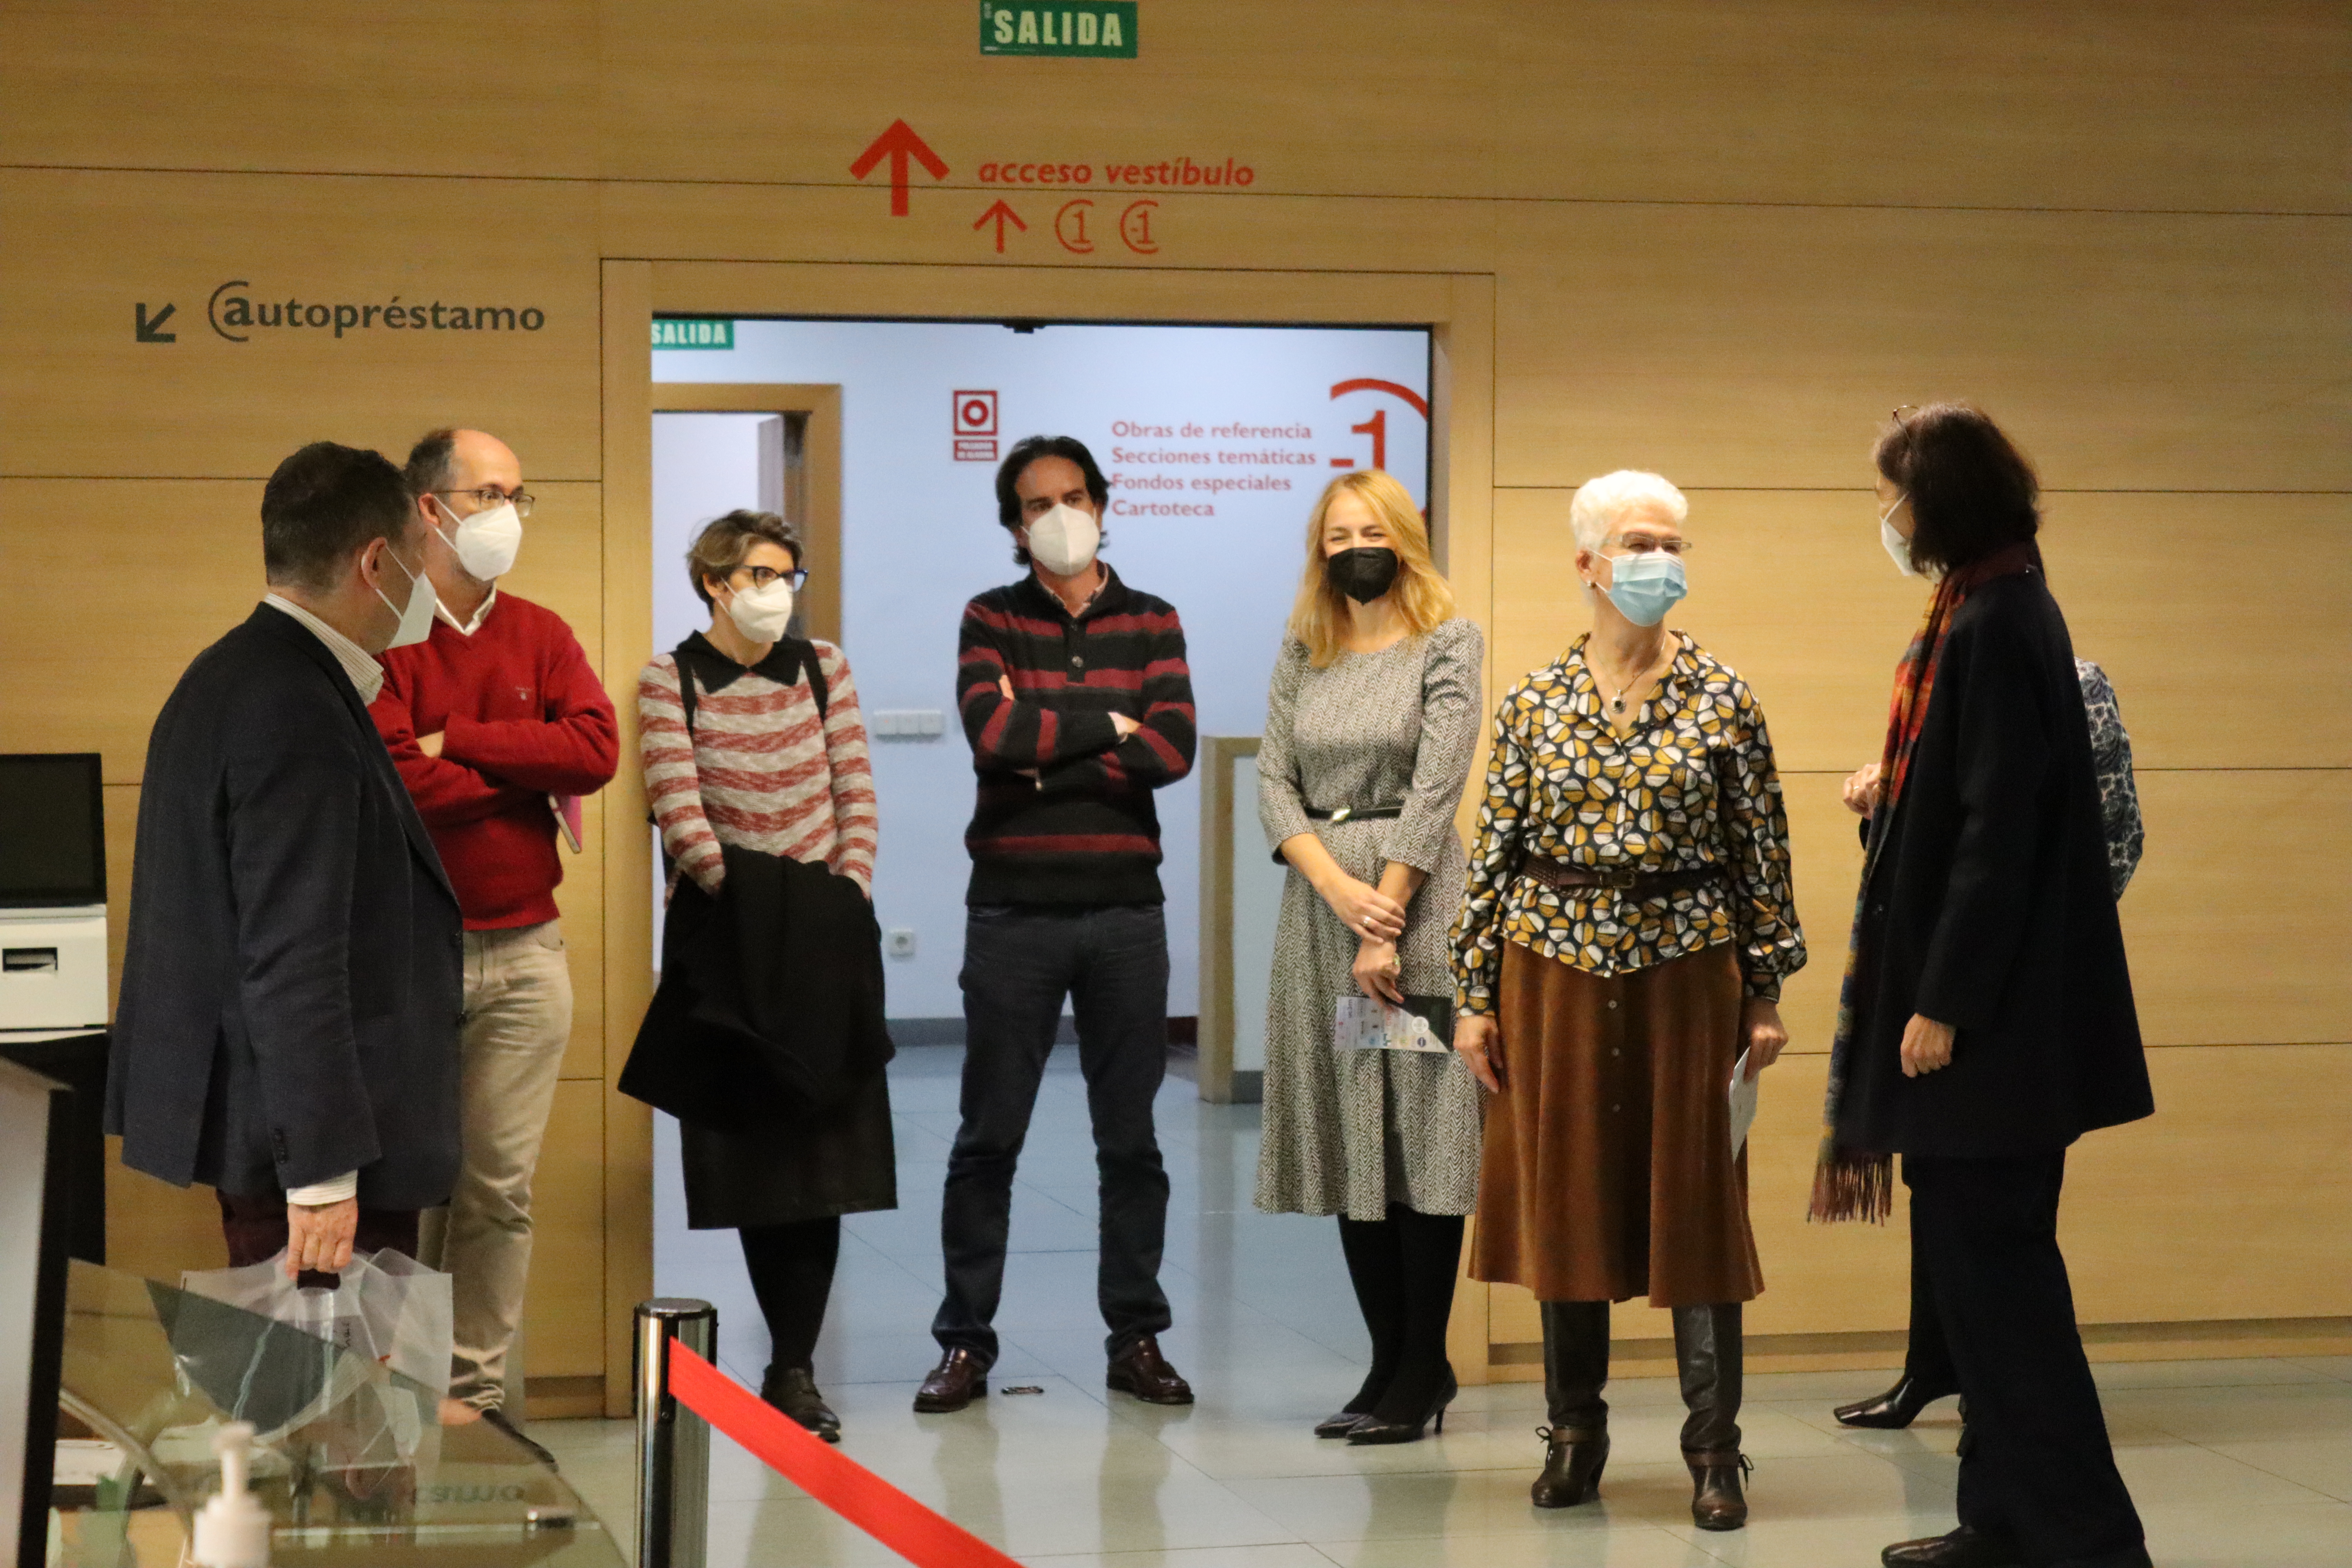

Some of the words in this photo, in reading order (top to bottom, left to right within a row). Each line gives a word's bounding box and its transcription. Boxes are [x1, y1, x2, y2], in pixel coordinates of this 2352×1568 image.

[994, 10, 1122, 46] SALIDA
[980, 163, 1091, 183] acceso
[1106, 157, 1253, 185] vestíbulo
[651, 323, 726, 344] SALIDA
[1112, 421, 1173, 437] Obras
[1180, 422, 1204, 437] de
[1211, 422, 1312, 438] referencia
[1112, 447, 1210, 464] Secciones
[1218, 448, 1316, 464] temáticas
[1112, 473, 1184, 490] Fondos
[1191, 474, 1290, 494] especiales
[1112, 499, 1214, 516] Cartoteca
